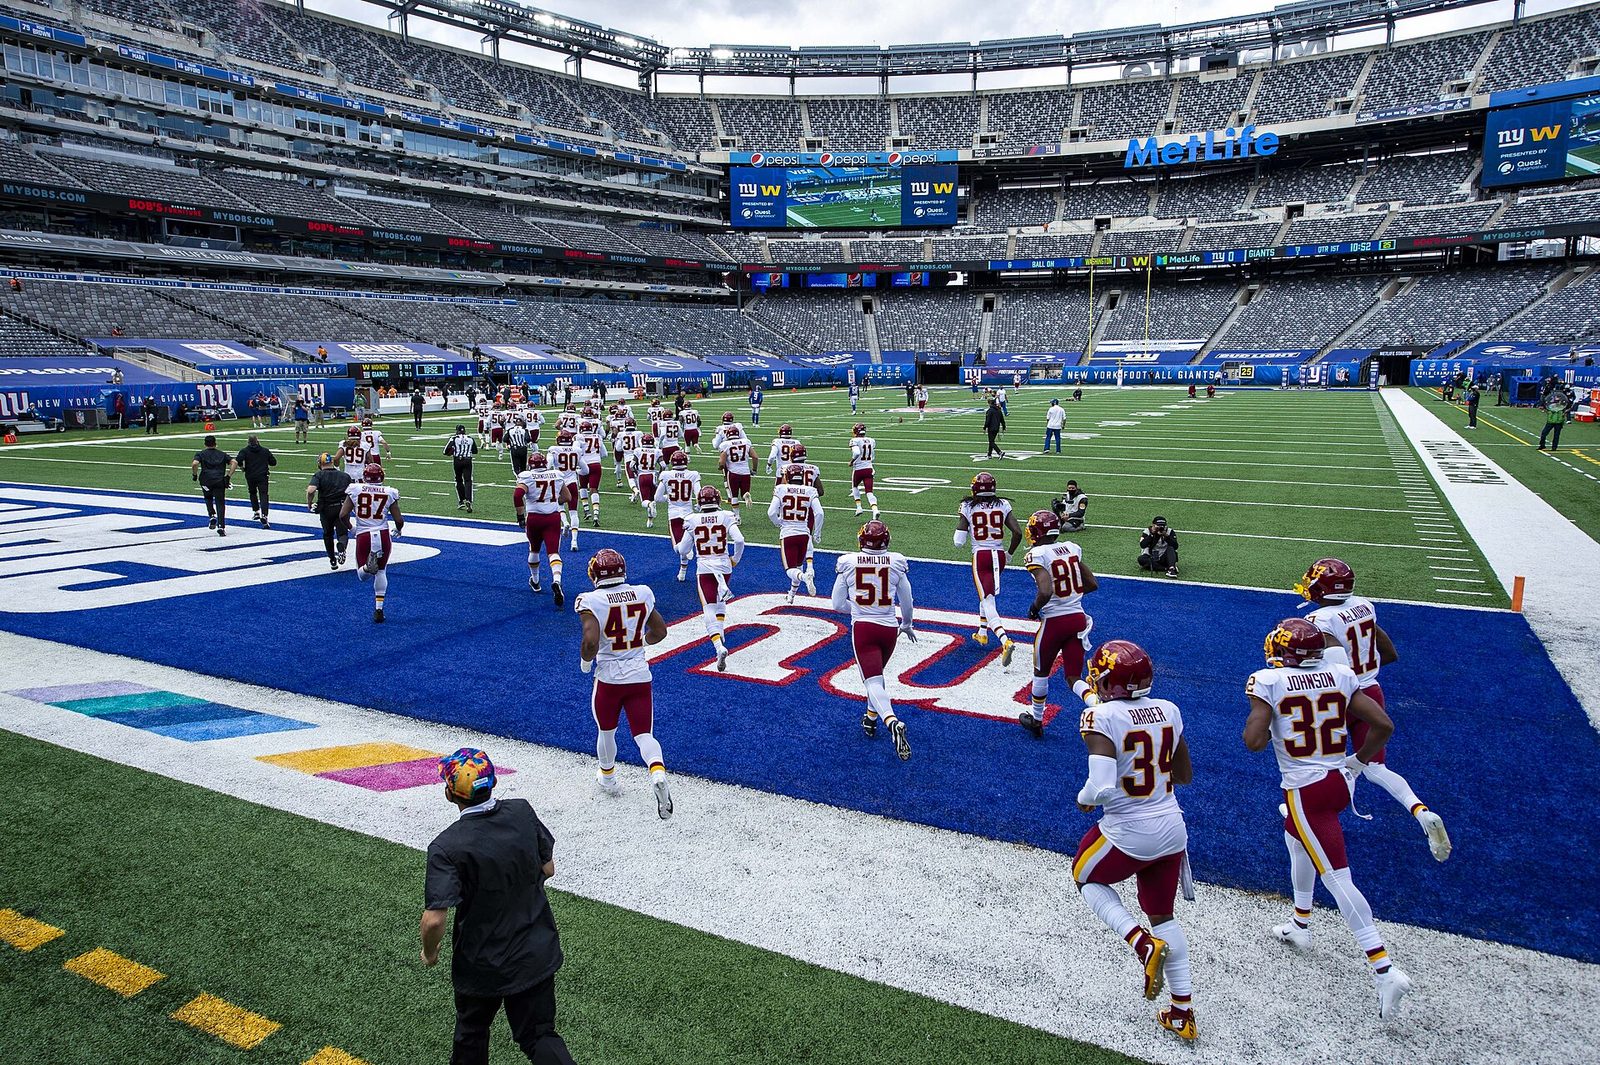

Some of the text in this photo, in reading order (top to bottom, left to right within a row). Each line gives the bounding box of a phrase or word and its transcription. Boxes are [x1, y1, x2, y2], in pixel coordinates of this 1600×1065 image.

[32, 27, 52, 38] BROWN
[1497, 124, 1562, 148] ny W
[1046, 145, 1056, 154] ny
[1124, 124, 1279, 168] MetLife
[766, 155, 800, 166] pepsi
[834, 154, 868, 166] pepsi
[903, 152, 937, 165] pepsi
[1500, 150, 1538, 159] PRESENTED
[1517, 159, 1542, 167] Quest
[3, 184, 85, 203] MYBOBS.COM
[738, 183, 781, 197] ny W
[911, 182, 954, 196] ny W
[129, 199, 163, 213] BOB'S
[213, 211, 274, 226] MYBOBS.COM
[308, 221, 334, 233] BOB'S
[1, 233, 51, 244] MetLife
[373, 229, 422, 243] MYBOBS.COM
[1483, 229, 1545, 241] MYBOBS.COM
[160, 248, 211, 259] METLIFE
[501, 244, 543, 255] MYBOBS.COM
[1350, 242, 1371, 252] 10:52
[1382, 241, 1392, 249] 25
[610, 255, 646, 264] MYBOBS.COM
[1084, 256, 1112, 266] WASHINGTON
[1169, 254, 1200, 263] MetLife
[1212, 252, 1225, 263] ny
[1248, 248, 1275, 259] GIANTS
[354, 265, 384, 273] MetLife
[705, 263, 738, 271] MYBOBS.COM
[1046, 260, 1054, 268] ON
[209, 366, 337, 376] NEW YORK FOOTBALL GIANTS
[531, 363, 558, 371] FOOTBALL
[1241, 367, 1252, 376] 25
[712, 372, 725, 390] ny
[771, 371, 785, 388] ny
[964, 368, 982, 384] ny
[1067, 369, 1215, 381] NEW YORK FOOTALL GIANTS
[37, 393, 195, 408] NEW YORK GIANTS
[197, 383, 233, 410] ny
[526, 412, 538, 423] 94
[563, 417, 576, 428] 73
[652, 411, 662, 421] 24
[685, 413, 697, 425] 60
[666, 425, 679, 438] 52
[366, 435, 374, 448] 9
[585, 437, 600, 453] 74
[623, 436, 635, 451] 31
[346, 447, 364, 463] 99
[730, 445, 746, 463] 67
[861, 444, 872, 461] 11
[558, 453, 578, 472] 90
[640, 453, 655, 470] 41
[536, 480, 557, 503] 71
[668, 479, 692, 502] 30
[357, 493, 388, 520] 87
[782, 495, 810, 522] 25
[701, 515, 718, 524] DARBY
[972, 510, 1004, 541] 89
[694, 524, 727, 556] 23
[857, 555, 891, 565] HAMILTON
[1051, 555, 1085, 599] 80
[856, 567, 892, 606] 51
[606, 591, 637, 604] HUDSON
[1338, 603, 1373, 625] McLAURIN
[604, 602, 647, 651] 47
[1274, 628, 1292, 647] 32
[1346, 619, 1378, 676] 17
[1286, 672, 1337, 692] JOHNSON
[1128, 706, 1167, 725] BARBER
[1278, 692, 1347, 758] 32
[1122, 726, 1173, 798] 34
